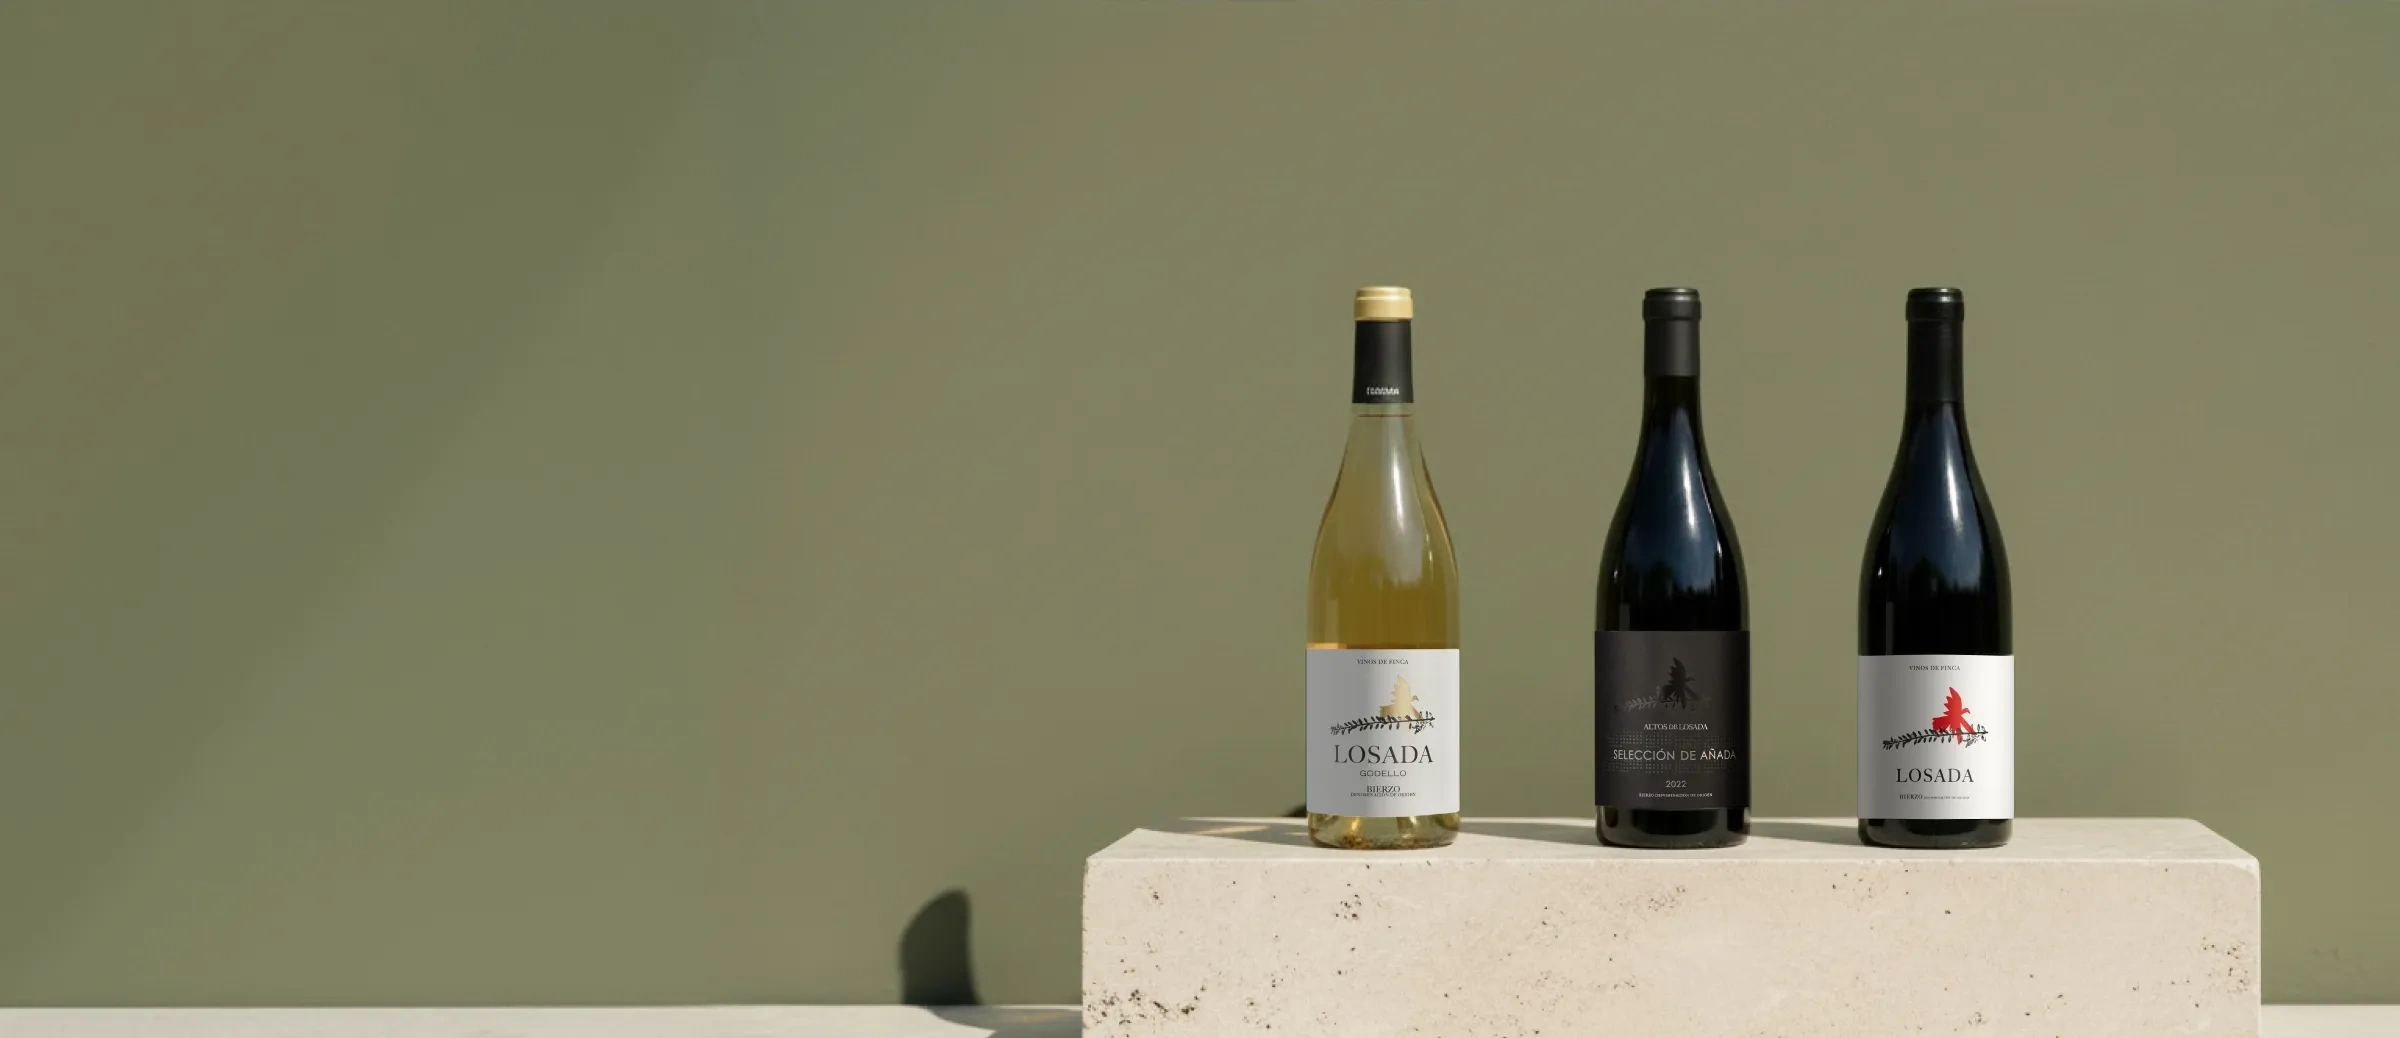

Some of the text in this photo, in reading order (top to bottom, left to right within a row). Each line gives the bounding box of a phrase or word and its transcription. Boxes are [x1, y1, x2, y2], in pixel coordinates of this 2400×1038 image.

[1334, 744, 1434, 764] LOSADA
[1613, 748, 1737, 761] SELECCIÓN DE AÑADA
[1896, 768, 1974, 783] LOSADA
[1366, 785, 1401, 793] BIERZO
[1665, 780, 1688, 788] 2022
